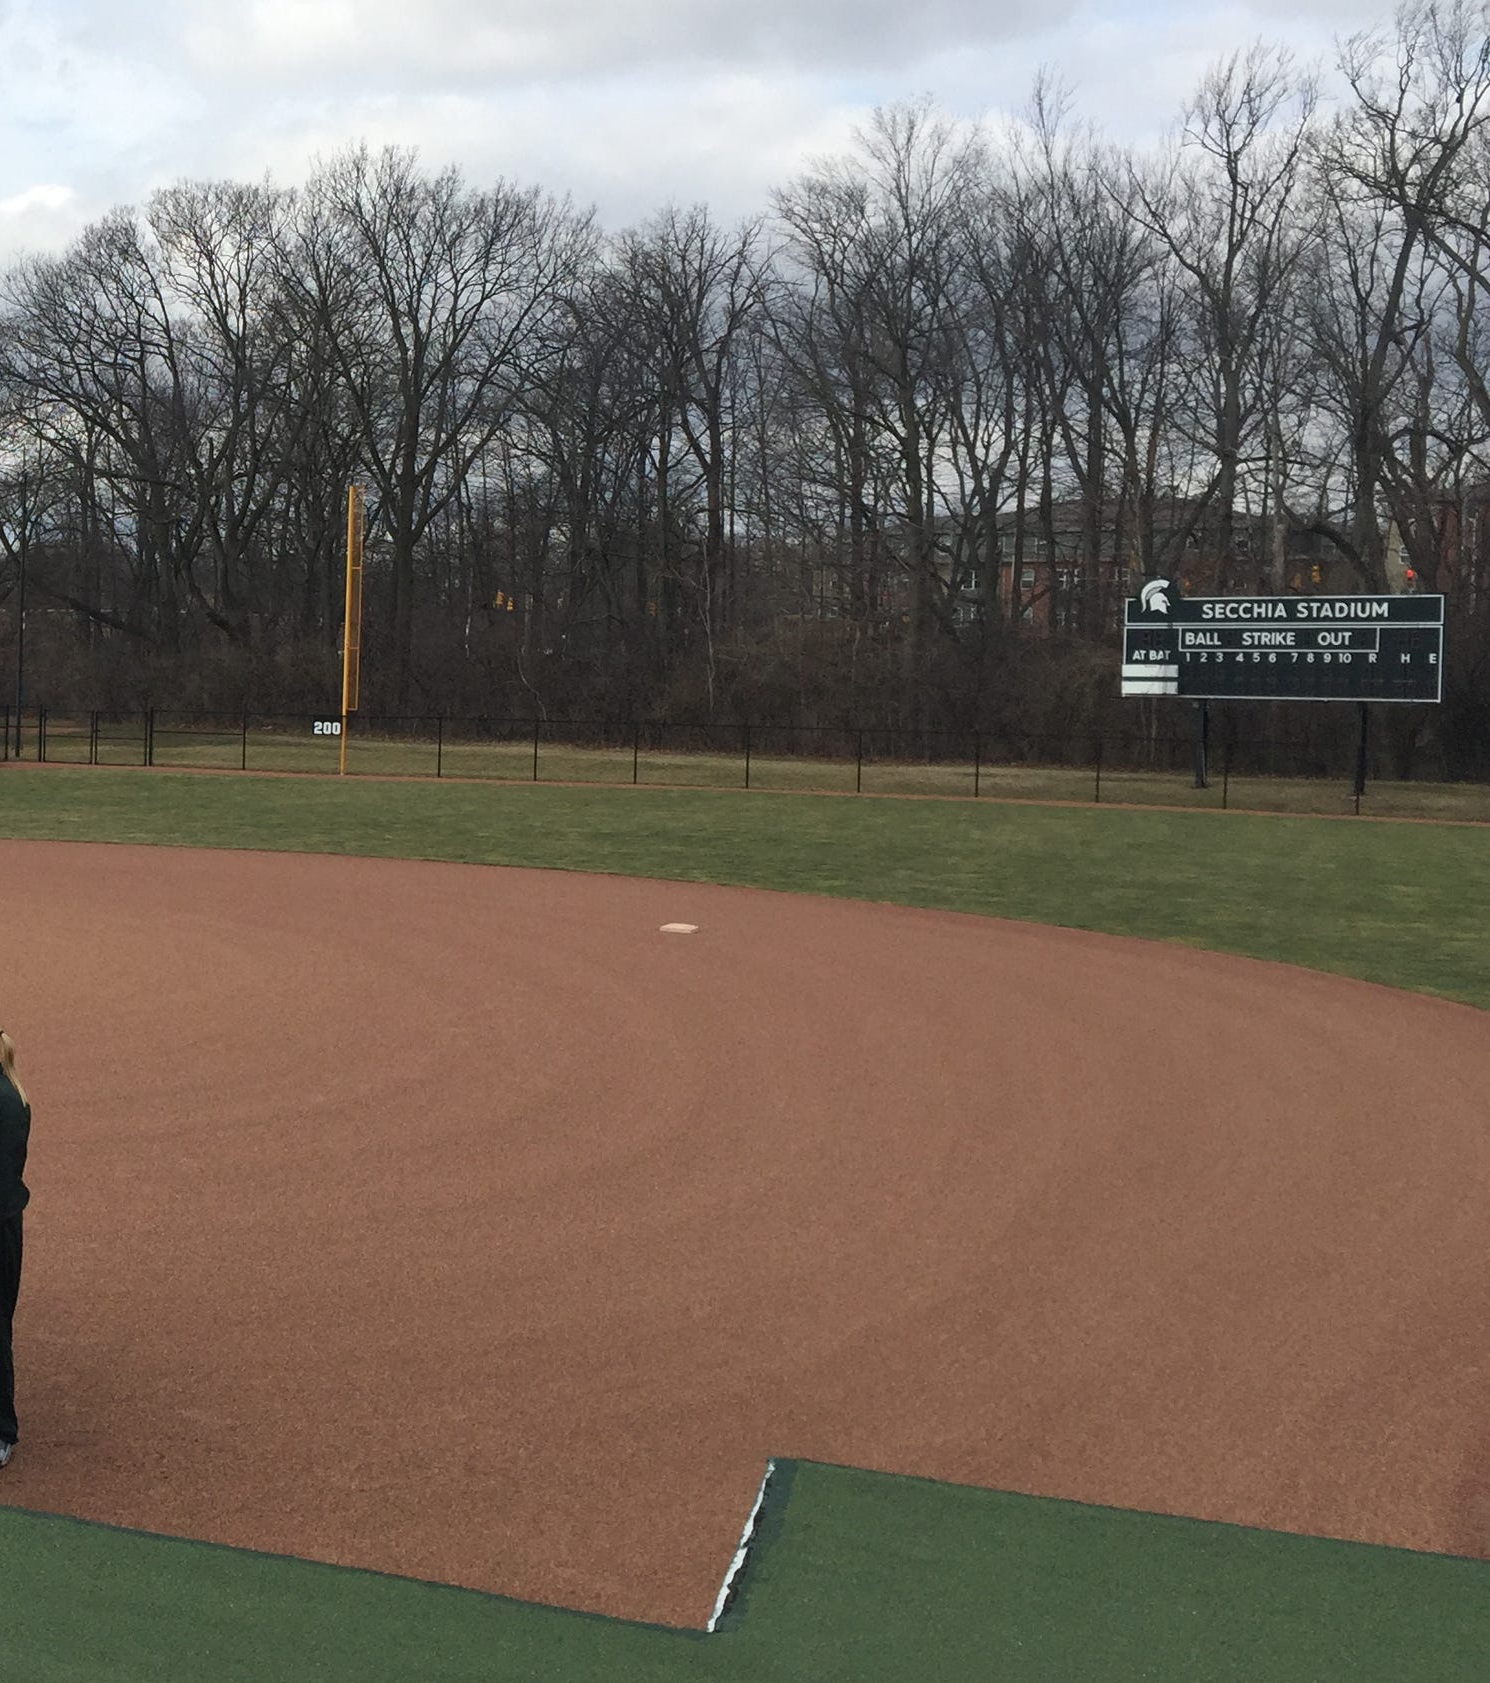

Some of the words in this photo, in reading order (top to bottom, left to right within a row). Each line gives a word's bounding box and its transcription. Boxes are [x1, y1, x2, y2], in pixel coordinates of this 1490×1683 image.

[1201, 602, 1287, 619] SECCHIA
[1296, 602, 1389, 618] STADIUM
[1184, 632, 1222, 646] BALL
[1241, 632, 1296, 646] STRIKE
[1317, 632, 1352, 646] OUT
[1132, 650, 1147, 661] AT
[1149, 650, 1171, 661] BAT
[1185, 652, 1191, 662] 1
[1200, 652, 1208, 662] 2
[1215, 652, 1224, 662] 3
[1235, 652, 1245, 663] 4
[1253, 652, 1261, 663] 5
[1268, 653, 1277, 663] 6
[1291, 653, 1299, 663] 7
[1306, 653, 1315, 663] 8
[1323, 653, 1332, 663] 9
[1339, 653, 1352, 663] 10
[1368, 653, 1377, 663] R
[1400, 653, 1411, 664] H
[1429, 653, 1438, 664] E
[313, 721, 341, 735] 200
